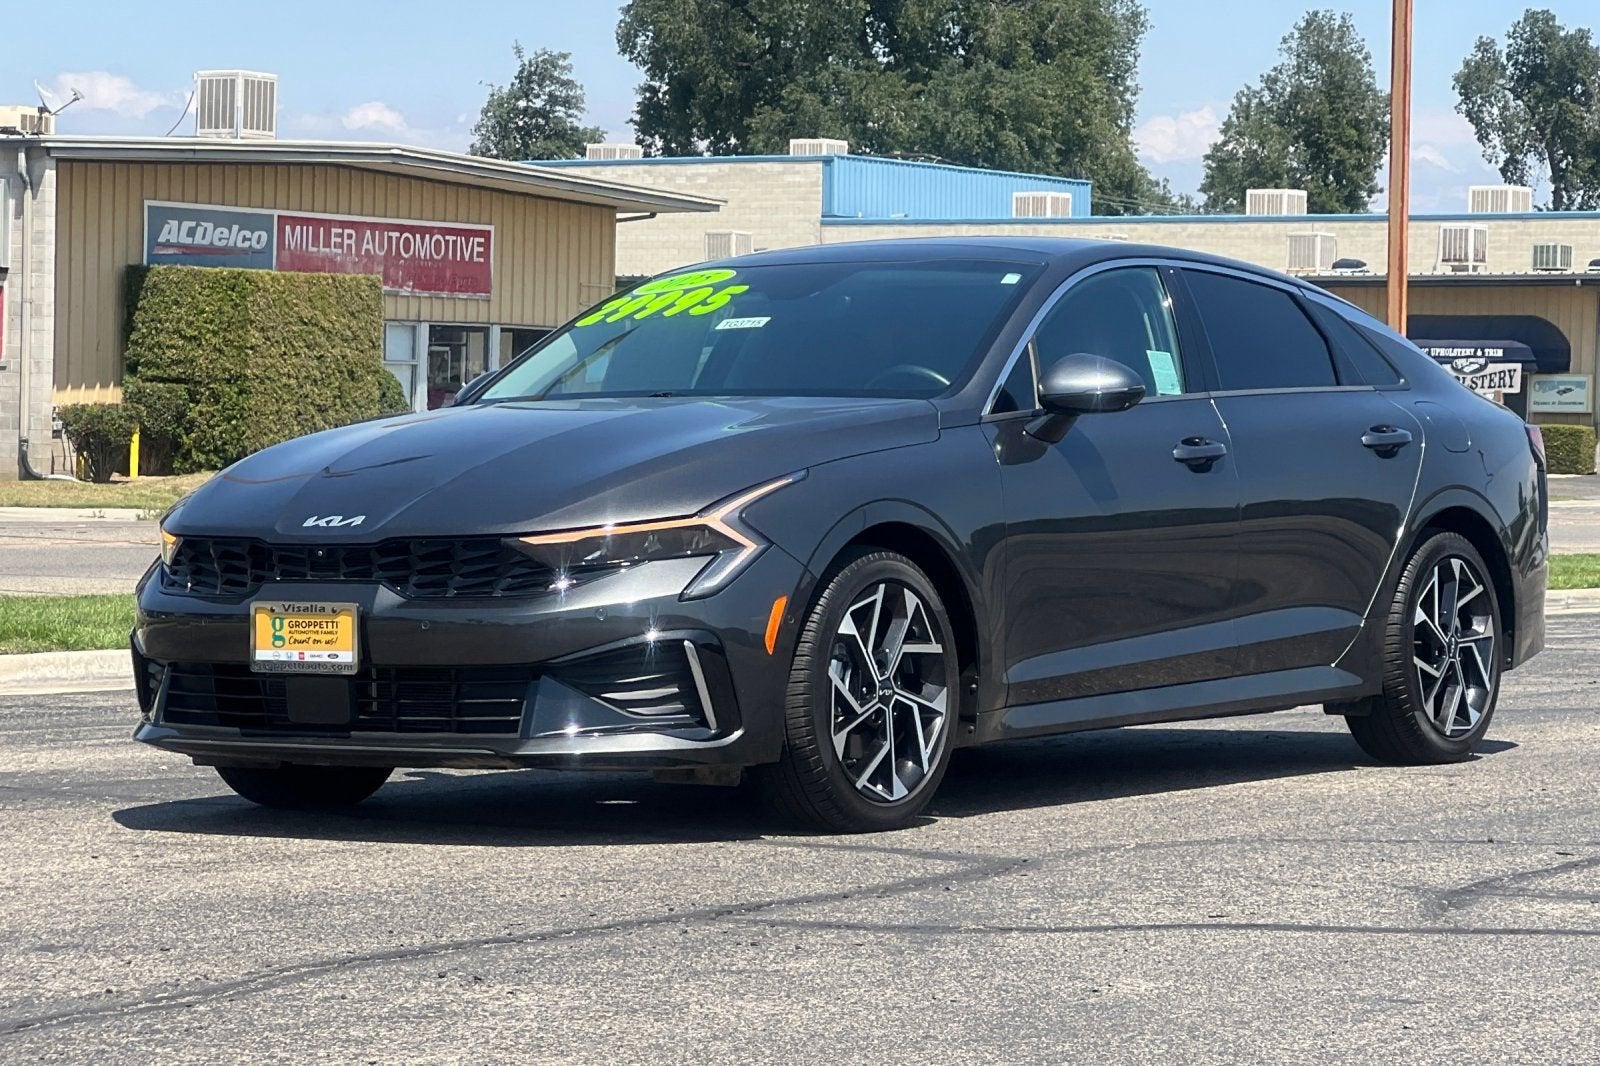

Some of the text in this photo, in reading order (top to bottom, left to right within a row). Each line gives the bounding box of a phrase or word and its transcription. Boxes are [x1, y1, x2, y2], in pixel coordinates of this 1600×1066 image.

[158, 219, 268, 249] ACDelco
[284, 224, 485, 263] MILLER AUTOMOTIVE
[575, 285, 750, 327] 29995
[1430, 347, 1475, 357] UPHOLSTERY
[1484, 348, 1504, 357] TRIM
[302, 515, 366, 527] KIA
[281, 603, 326, 613] Visalia
[288, 620, 339, 629] GROPPETTI
[288, 635, 311, 645] Count
[324, 636, 339, 646] us!
[255, 661, 353, 672] groppettiauto.com
